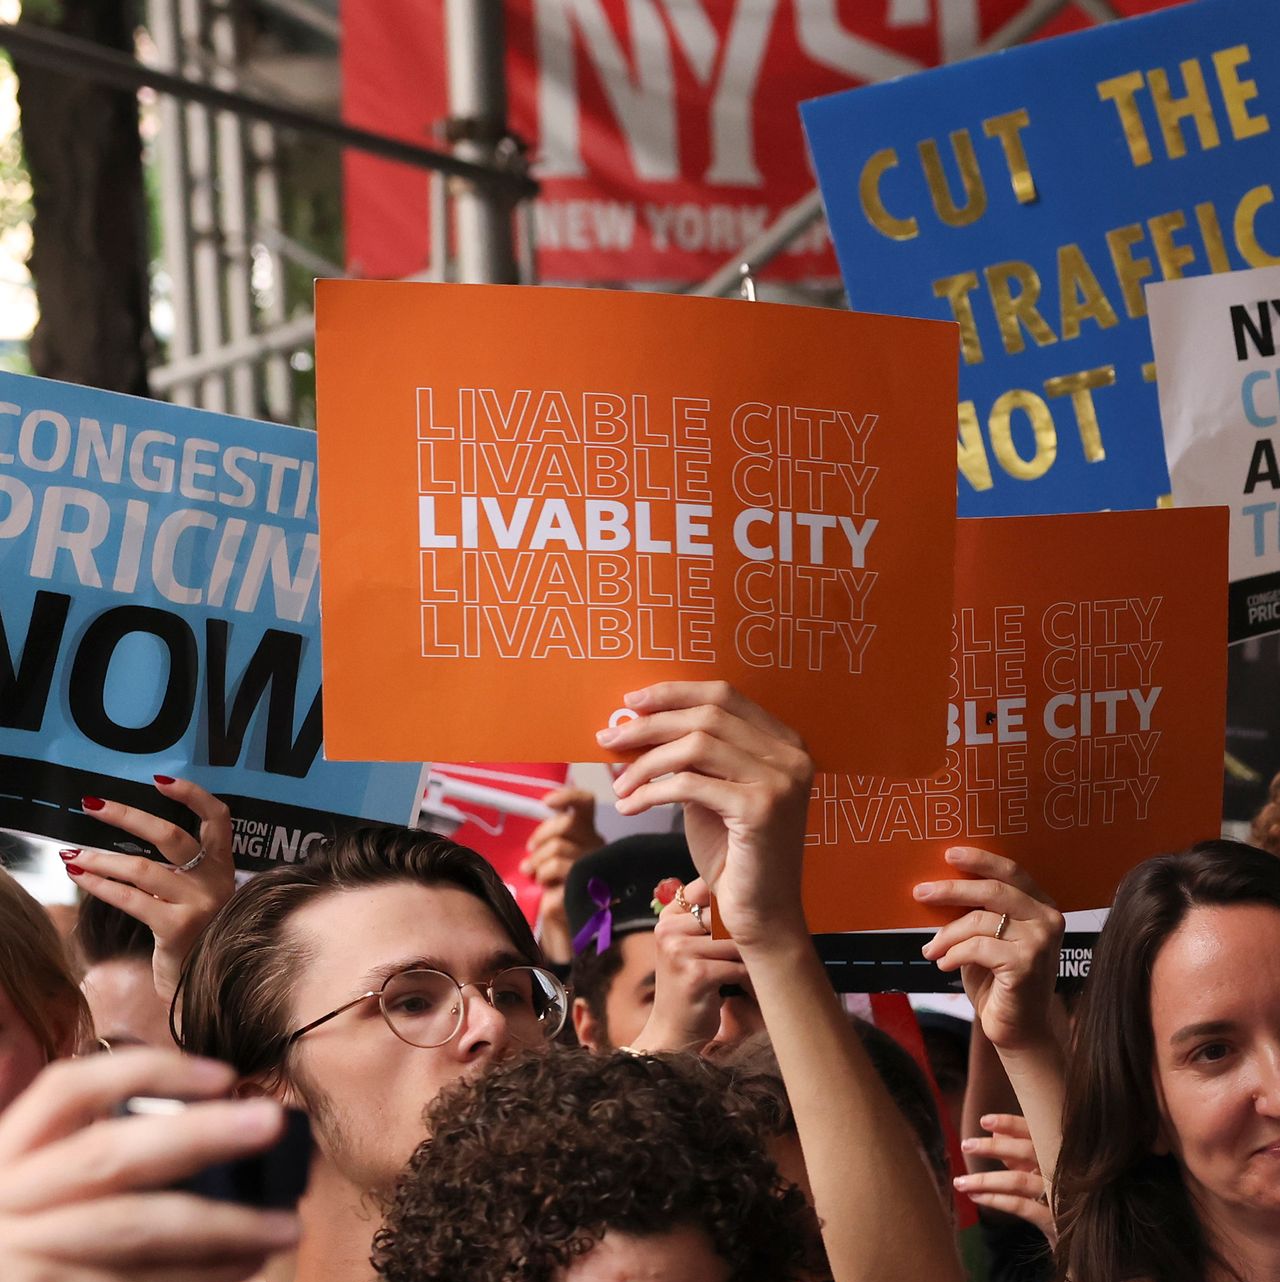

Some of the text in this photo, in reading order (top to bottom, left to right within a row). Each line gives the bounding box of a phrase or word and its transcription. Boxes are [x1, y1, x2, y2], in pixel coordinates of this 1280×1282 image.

[858, 45, 1270, 241] CUT THE
[537, 203, 635, 250] NEW
[646, 203, 769, 252] YORK
[416, 387, 878, 464] LIVABLE CITY
[0, 403, 318, 519] ONGESTI
[417, 443, 878, 516] LIVABLE CITY
[0, 477, 319, 622] RICIN
[418, 497, 879, 568] LIVABLE CITY
[419, 551, 878, 621] LIVABLE CITY
[420, 606, 877, 674] LIVABLE CITY
[1042, 596, 1163, 649] CITY
[1042, 641, 1162, 694] CITY
[1043, 686, 1162, 739] CITY
[1044, 731, 1161, 785] CITY
[1044, 776, 1160, 830] CITY
[269, 826, 327, 863] NO
